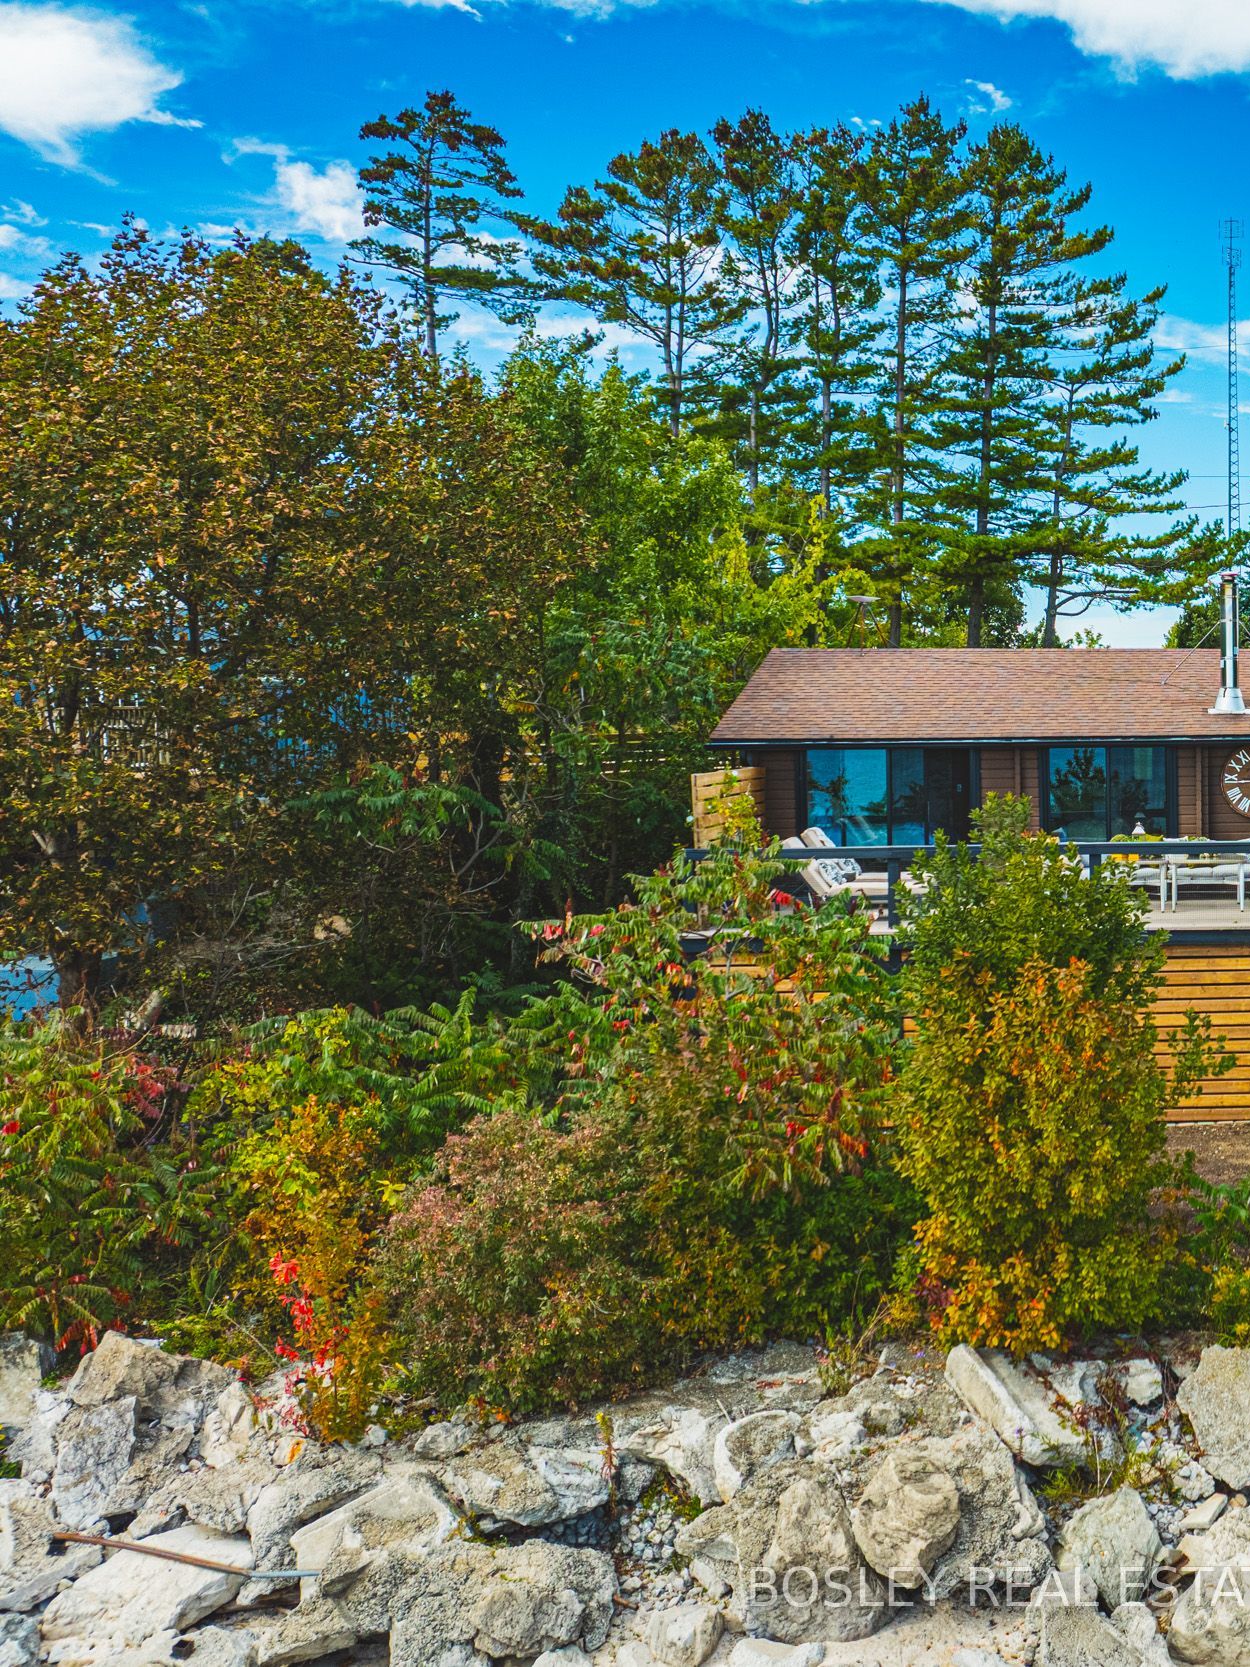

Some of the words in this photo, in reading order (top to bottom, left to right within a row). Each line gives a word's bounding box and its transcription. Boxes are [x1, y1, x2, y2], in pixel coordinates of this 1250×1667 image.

[1235, 749, 1250, 765] XI
[1228, 759, 1243, 772] X
[1224, 773, 1238, 784] IX
